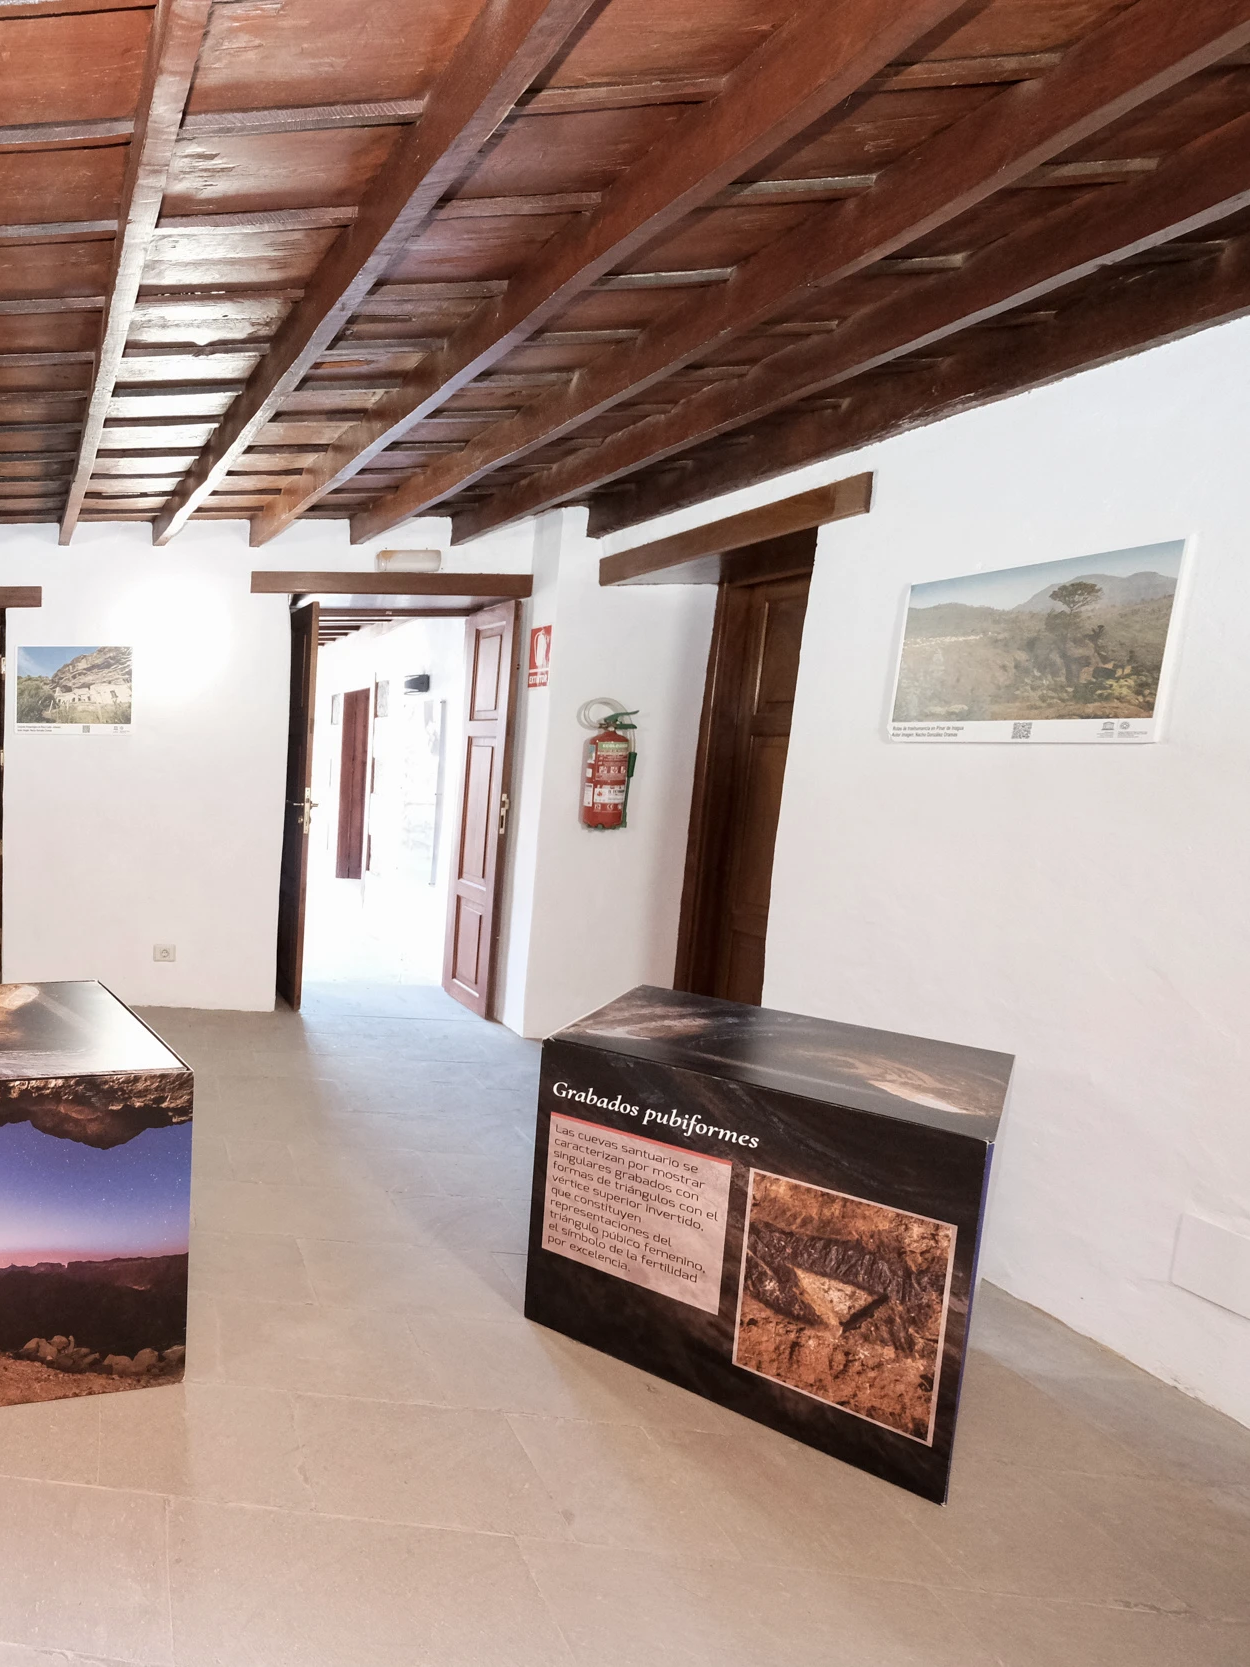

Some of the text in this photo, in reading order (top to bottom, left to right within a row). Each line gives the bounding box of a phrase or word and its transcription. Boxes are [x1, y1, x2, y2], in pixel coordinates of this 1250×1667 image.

[552, 1081, 760, 1149] Grabados pubiformes
[554, 1138, 706, 1189] caracterizan por mostrar
[555, 1124, 699, 1173] Las cuevas santuario se
[552, 1174, 590, 1193] vértice
[592, 1187, 643, 1210] superior
[553, 1150, 699, 1202] singulares grabados con
[553, 1160, 719, 1222] formas de triángulos con el
[549, 1210, 599, 1234] triángulo
[601, 1229, 641, 1250] púbico
[550, 1199, 672, 1248] representaciones del
[551, 1187, 642, 1224] que constituyen
[547, 1235, 631, 1272] por excelencia.
[548, 1223, 698, 1284] el símbolo de la fertilidad
